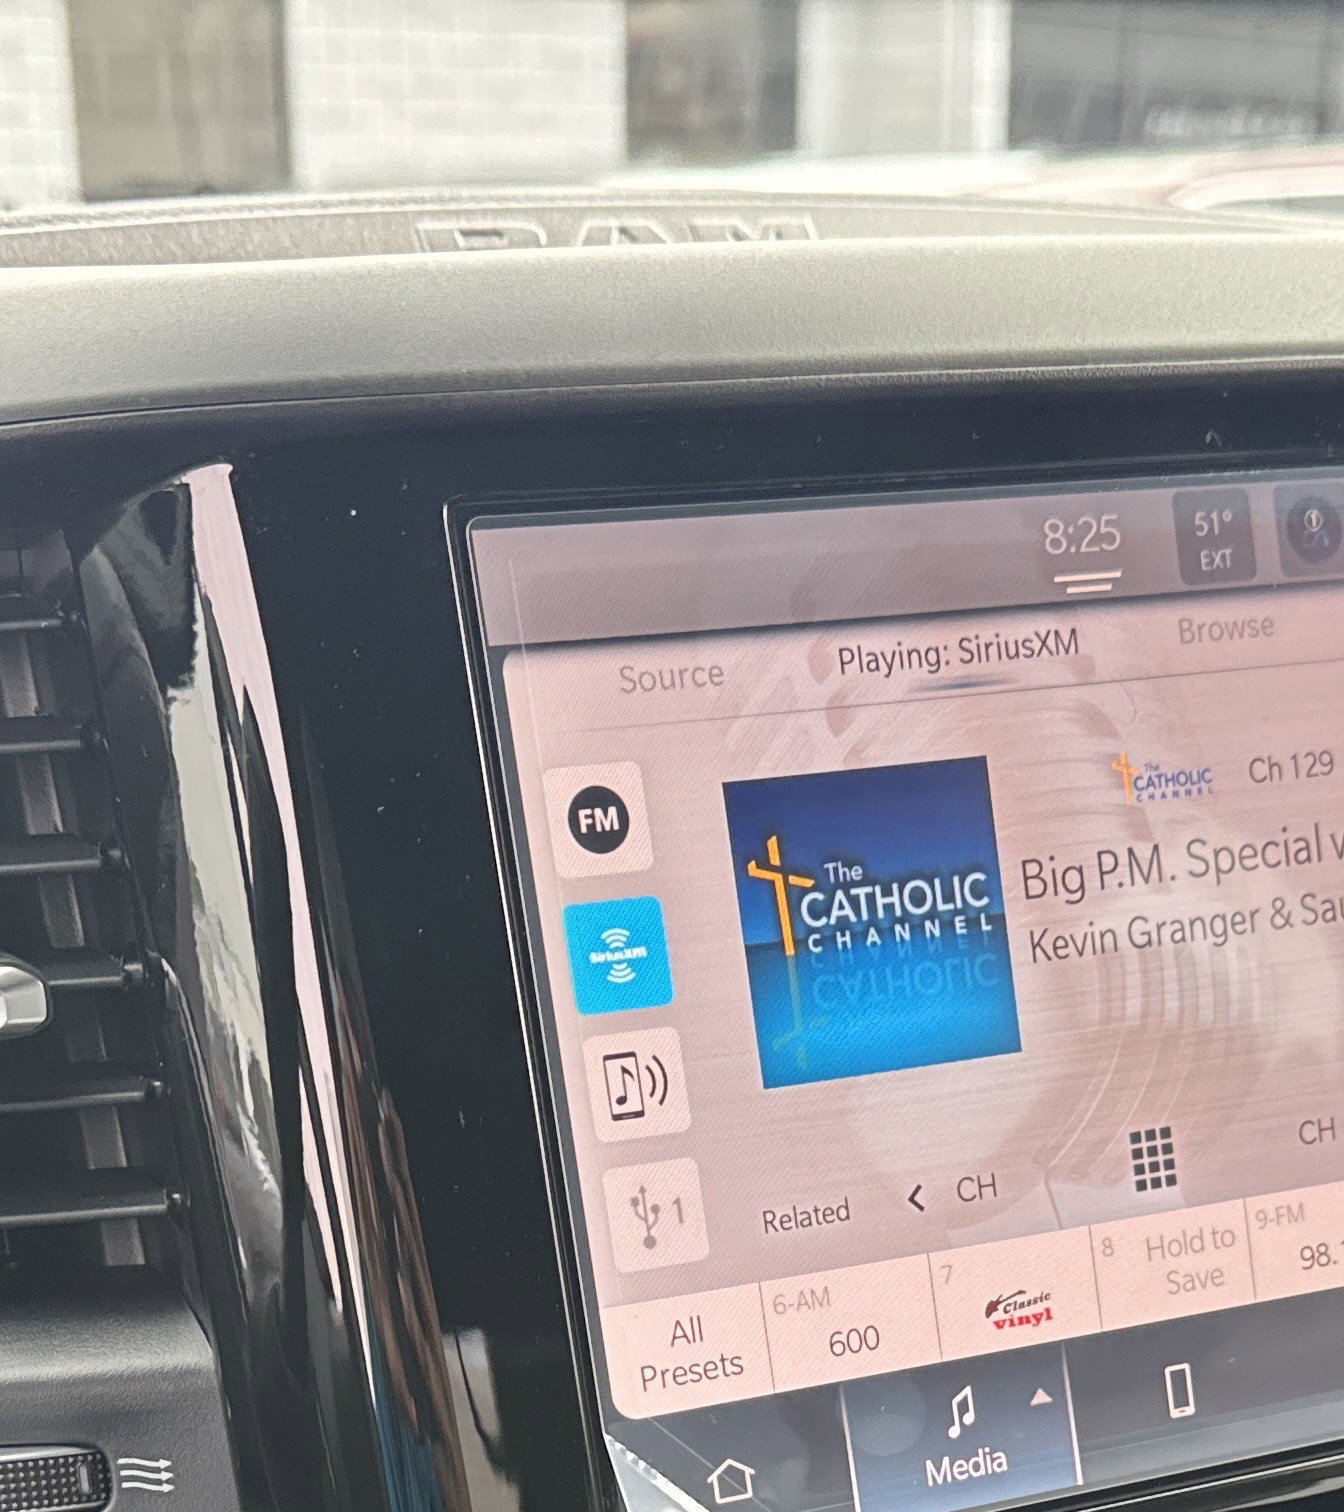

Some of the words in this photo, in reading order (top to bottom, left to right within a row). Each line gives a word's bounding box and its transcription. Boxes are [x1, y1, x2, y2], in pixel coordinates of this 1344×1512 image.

[1044, 515, 1122, 555] 8:25
[1193, 508, 1233, 538] 51°
[1200, 549, 1232, 570] EXT
[1178, 614, 1274, 646] Browse
[838, 636, 951, 676] Playing:
[958, 628, 1079, 665] SiriusXM
[620, 664, 724, 694] Source
[1133, 768, 1212, 791] CATHOLIC
[1249, 756, 1282, 783] Ch
[1291, 750, 1334, 779] 129
[1136, 786, 1213, 802] CHANNEL
[578, 805, 620, 834] FM
[824, 861, 863, 885] The
[1020, 858, 1086, 904] Big
[1097, 846, 1176, 892] P.M.
[1186, 824, 1322, 884] Special
[800, 872, 990, 928] CATHOLIC
[808, 913, 992, 953] CHANNEL
[1029, 924, 1119, 964] Kevin
[1127, 905, 1259, 948] Granger
[1270, 898, 1293, 929] &
[1299, 1118, 1336, 1145] CH
[957, 1173, 998, 1202] CH
[762, 1198, 850, 1235] Related
[1255, 1202, 1305, 1230] 9-FM
[1102, 1238, 1115, 1258] 8
[1146, 1231, 1203, 1262] Hold
[1210, 1227, 1236, 1249] to
[941, 1266, 953, 1286] 7
[1166, 1267, 1224, 1295] Save
[773, 1287, 831, 1315] 6-AM
[1002, 1291, 1051, 1314] Classic
[670, 1316, 703, 1347] All
[993, 1307, 1053, 1329] vinyl
[829, 1326, 880, 1357] 600
[640, 1353, 744, 1392] Presets
[925, 1448, 1008, 1487] Media
